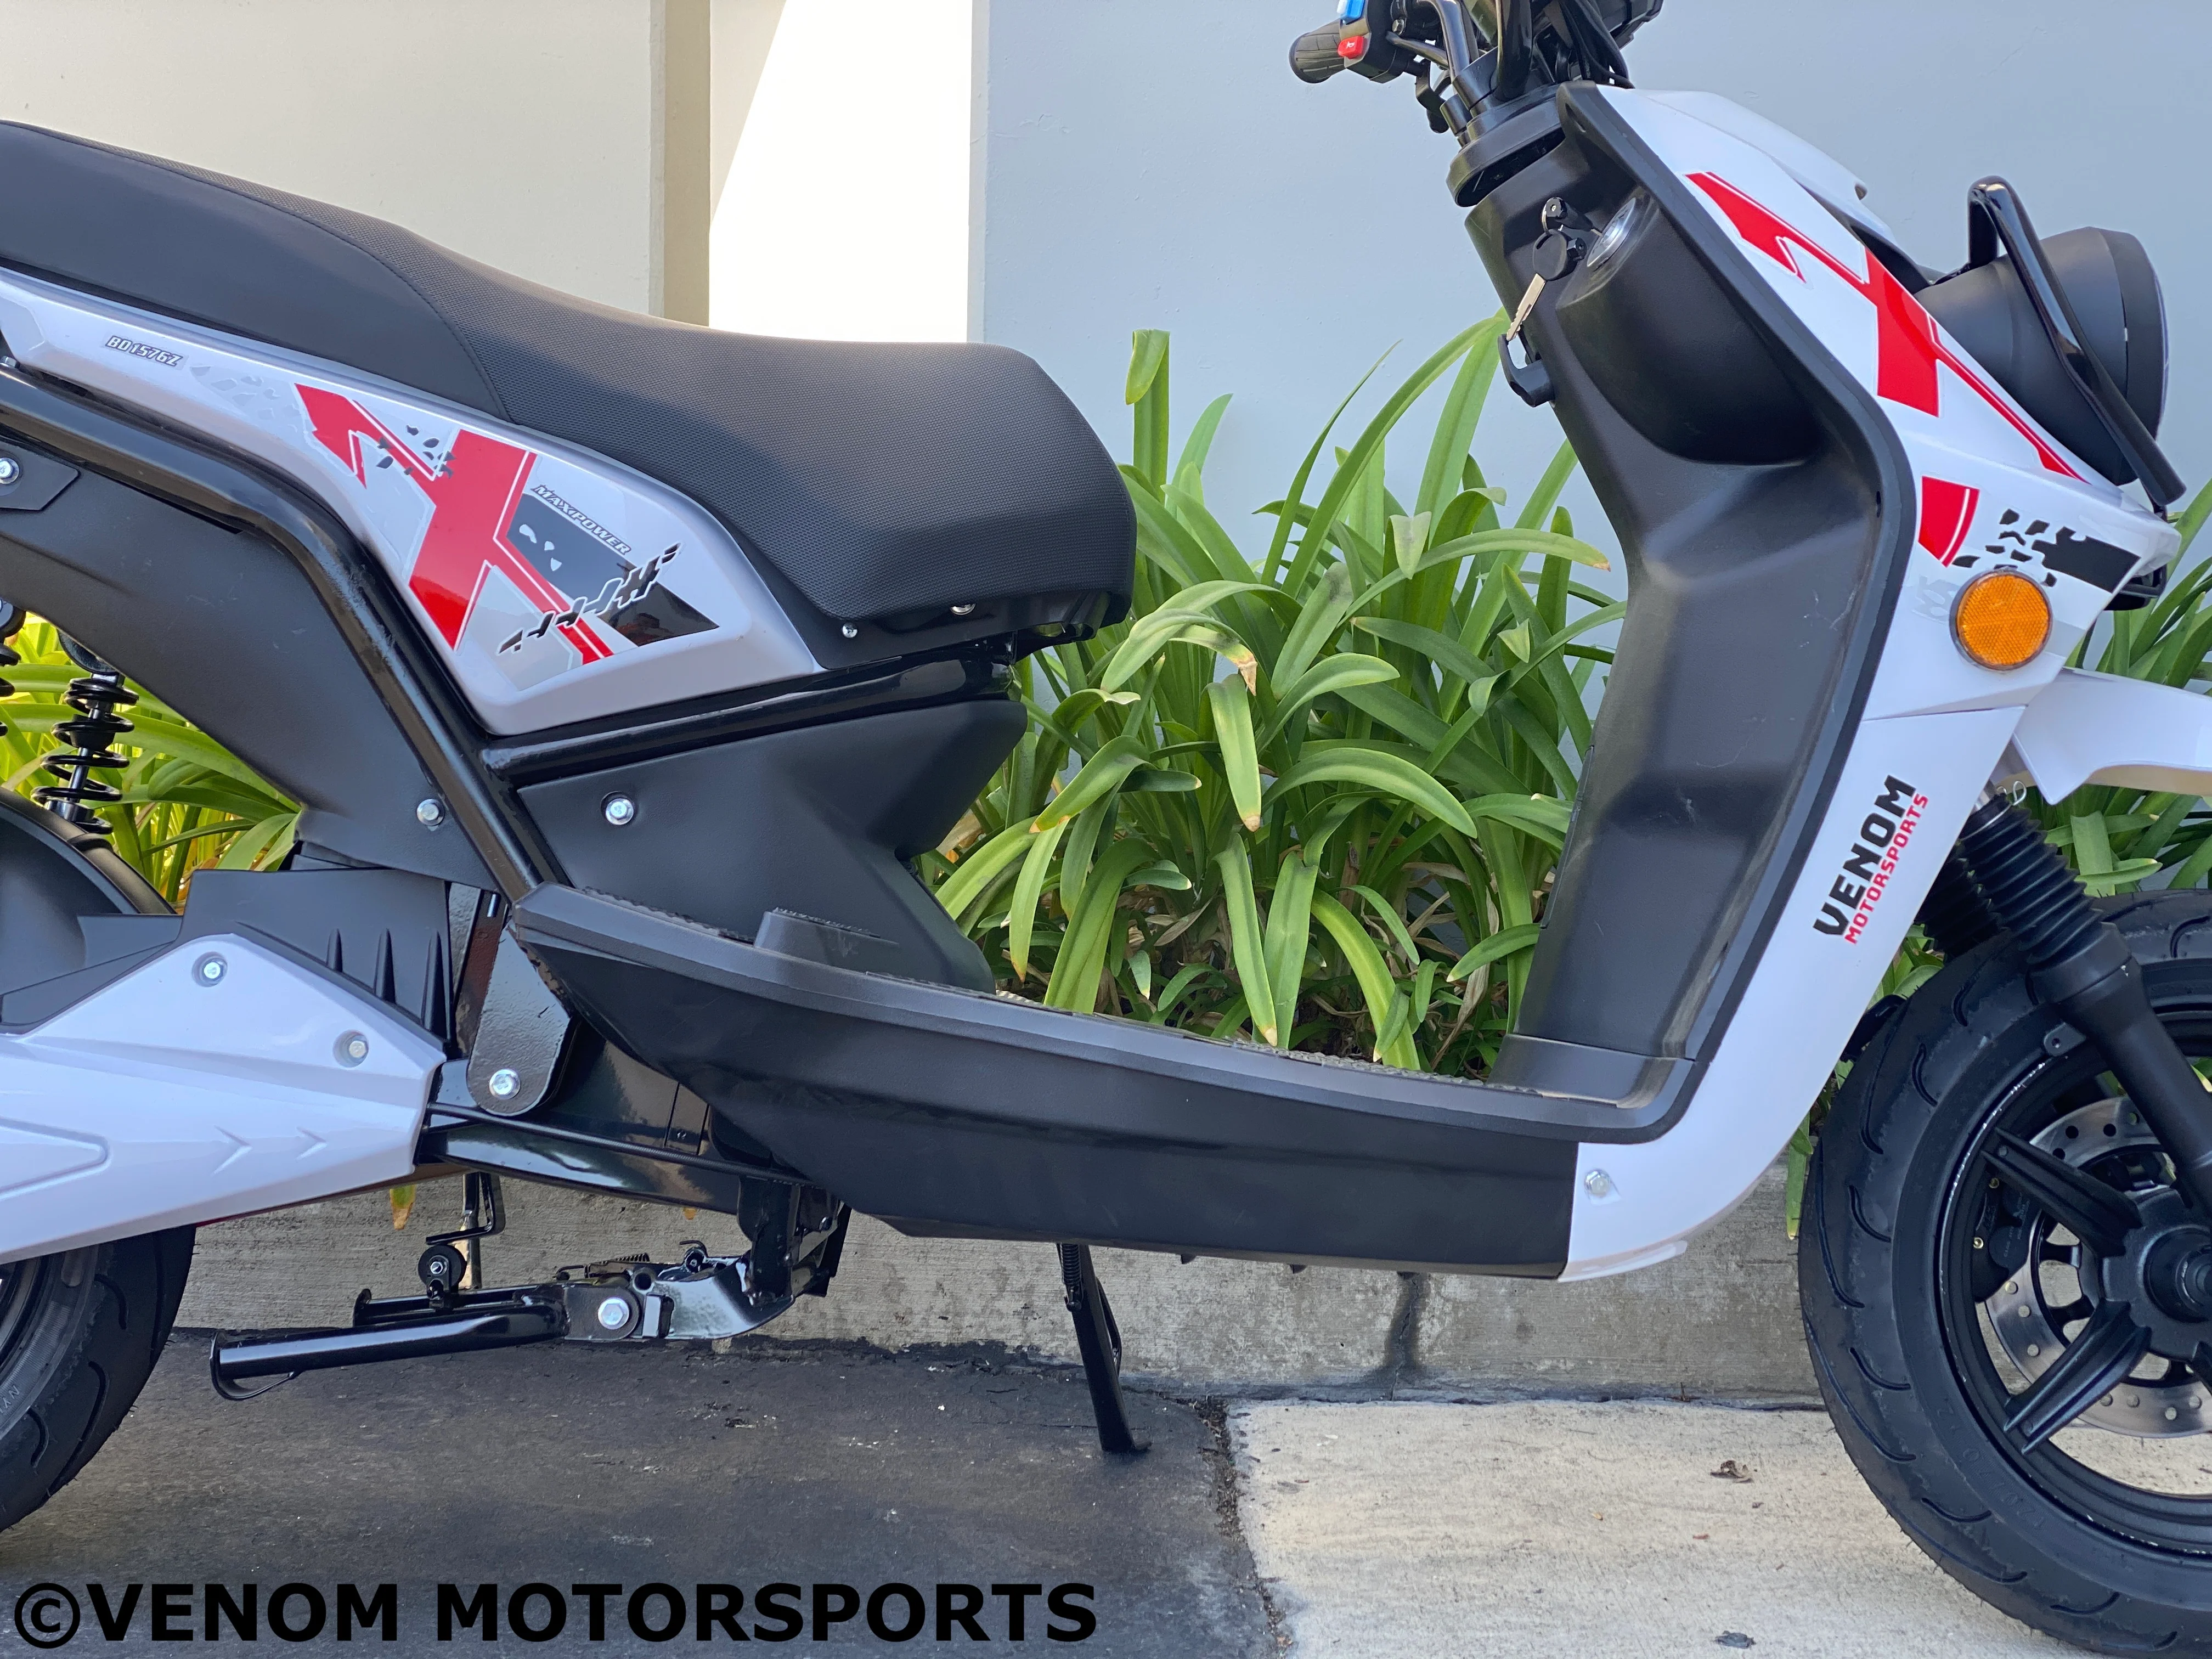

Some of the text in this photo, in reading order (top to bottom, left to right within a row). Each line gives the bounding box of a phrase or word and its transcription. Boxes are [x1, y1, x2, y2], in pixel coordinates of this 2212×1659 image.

[531, 484, 632, 555] MAXPOWER
[1812, 774, 1916, 935] VENOM
[1844, 793, 1929, 945] MOTORSPORTS
